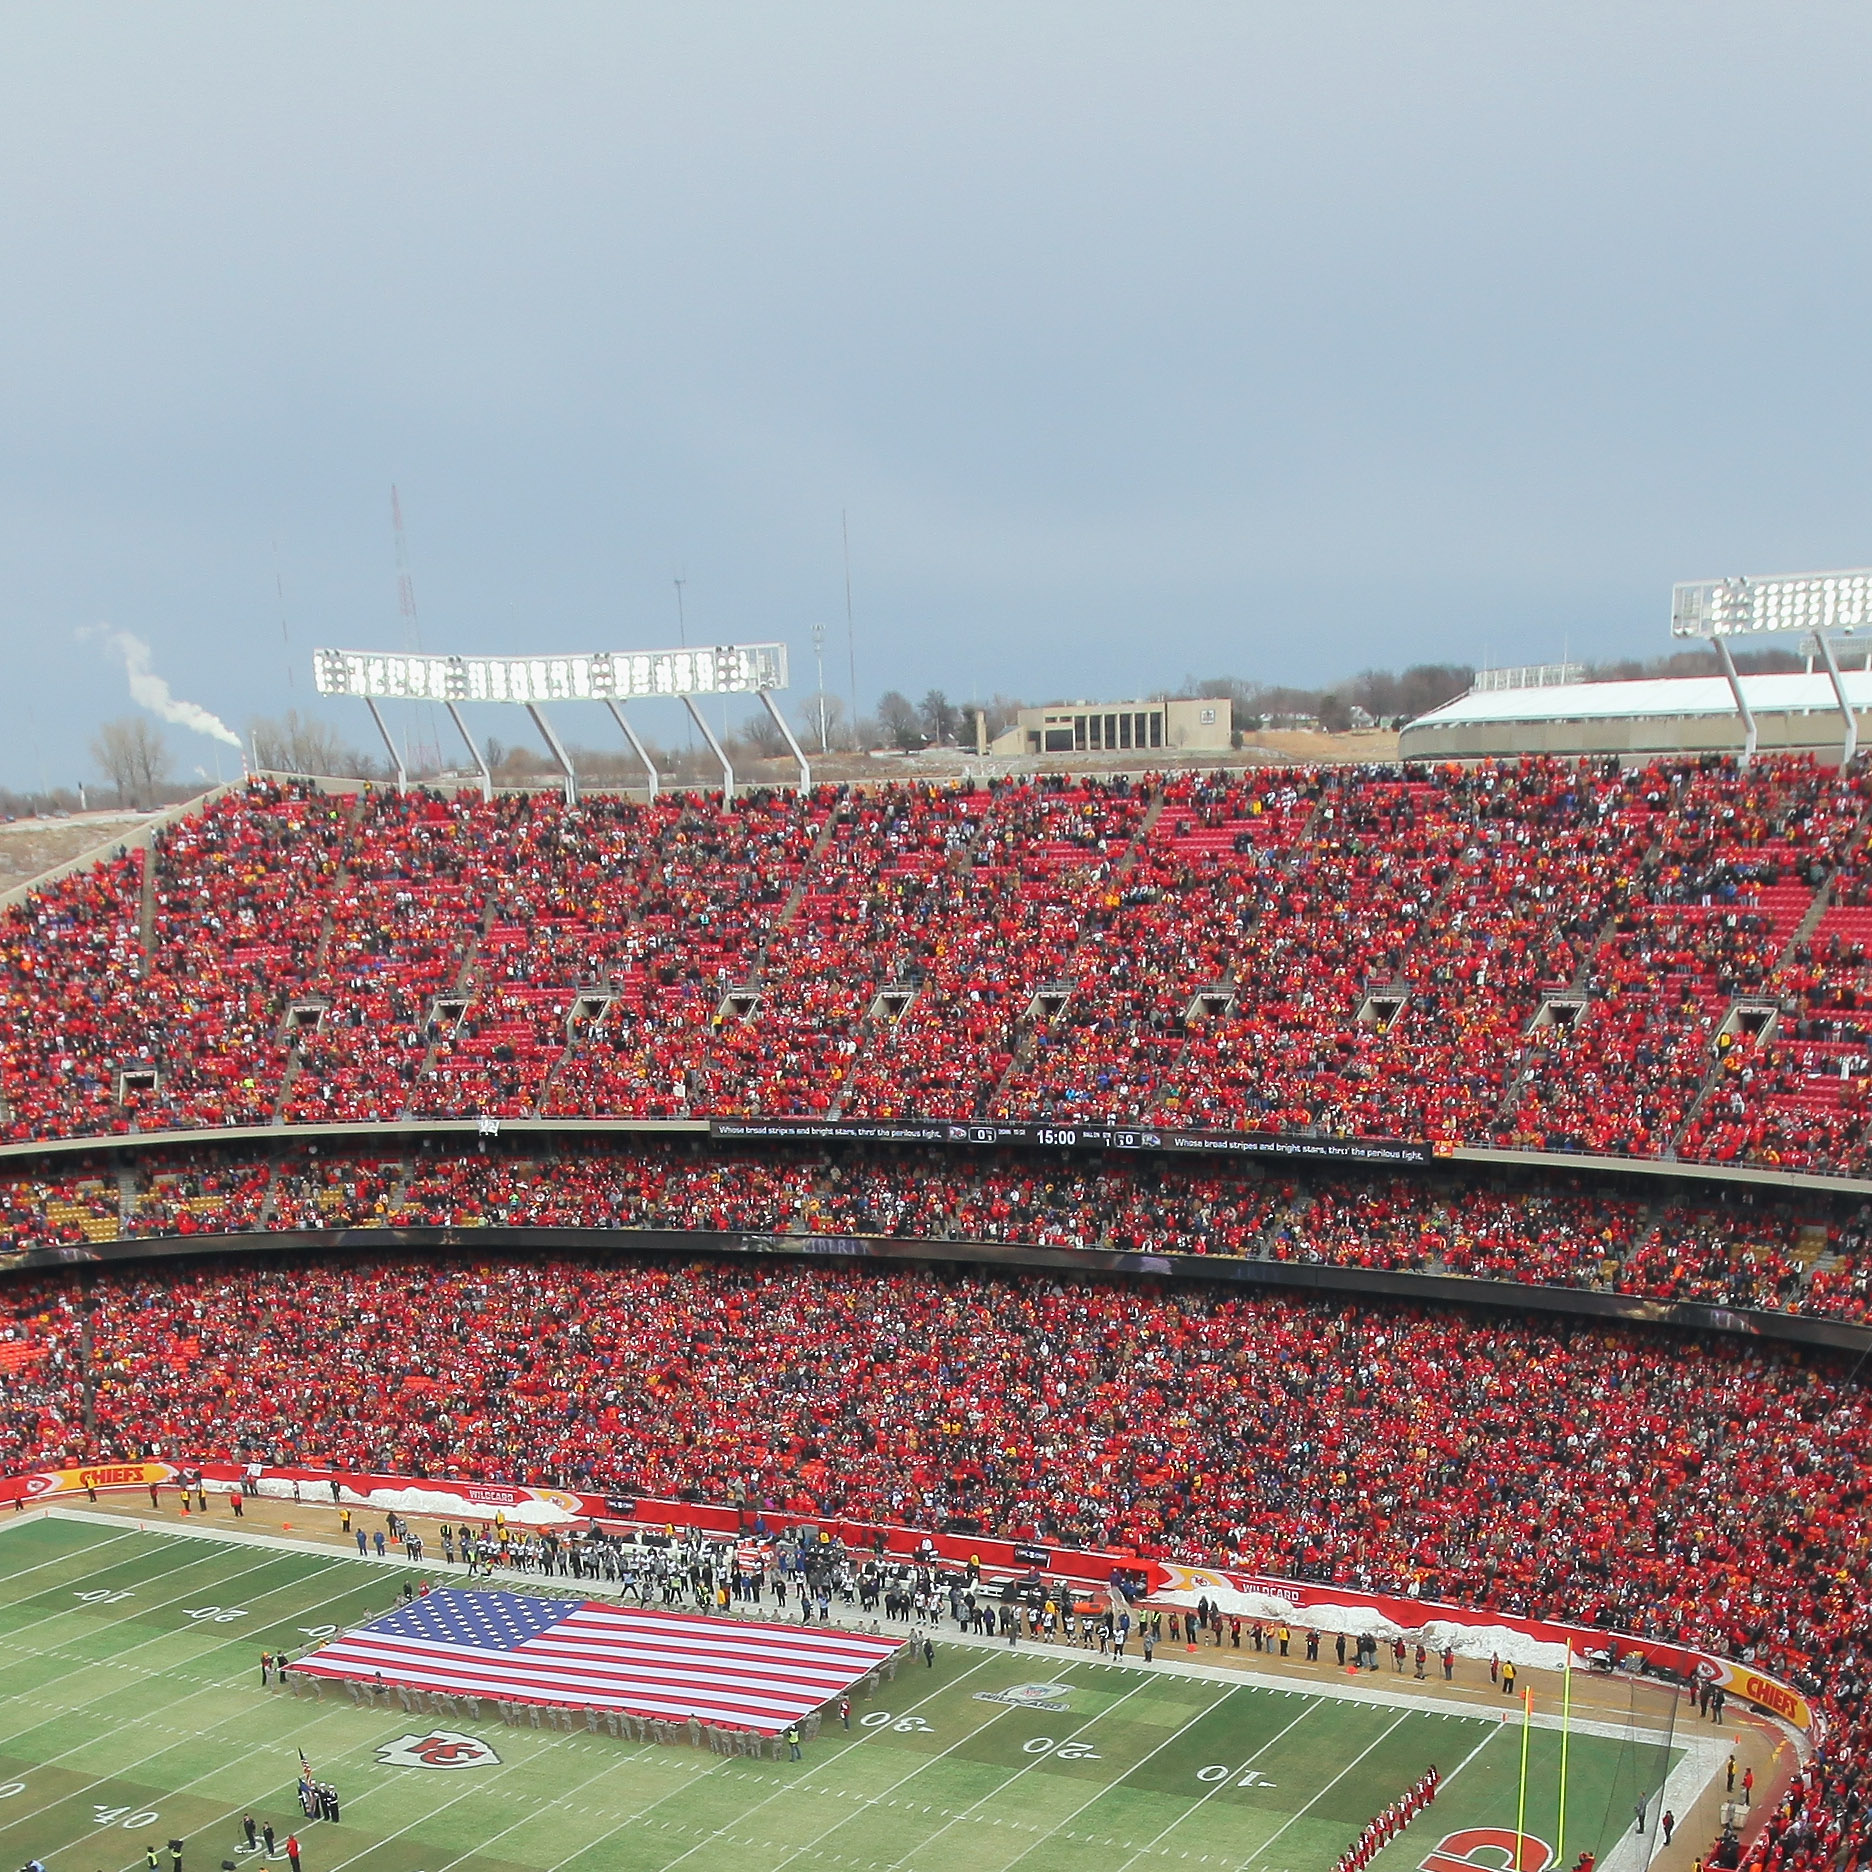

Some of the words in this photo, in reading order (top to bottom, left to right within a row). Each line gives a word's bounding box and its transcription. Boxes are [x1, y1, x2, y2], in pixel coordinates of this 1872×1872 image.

[718, 1126, 744, 1134] Whose
[768, 1127, 795, 1136] stripes
[811, 1127, 834, 1136] bright
[891, 1129, 921, 1138] perilous
[977, 1129, 986, 1140] 0
[1037, 1129, 1076, 1145] 15:00
[1125, 1134, 1134, 1145] 0
[1174, 1138, 1203, 1147] Whose
[1204, 1140, 1228, 1149] broad
[1229, 1141, 1258, 1151] stripes
[1259, 1142, 1275, 1151] and
[1276, 1143, 1301, 1153] bright
[1351, 1147, 1365, 1156] the
[1367, 1148, 1400, 1158] perilous
[79, 1467, 144, 1485] CHIEFS
[469, 1489, 514, 1503] WILDCARD
[1746, 1677, 1798, 1719] CHIEFS
